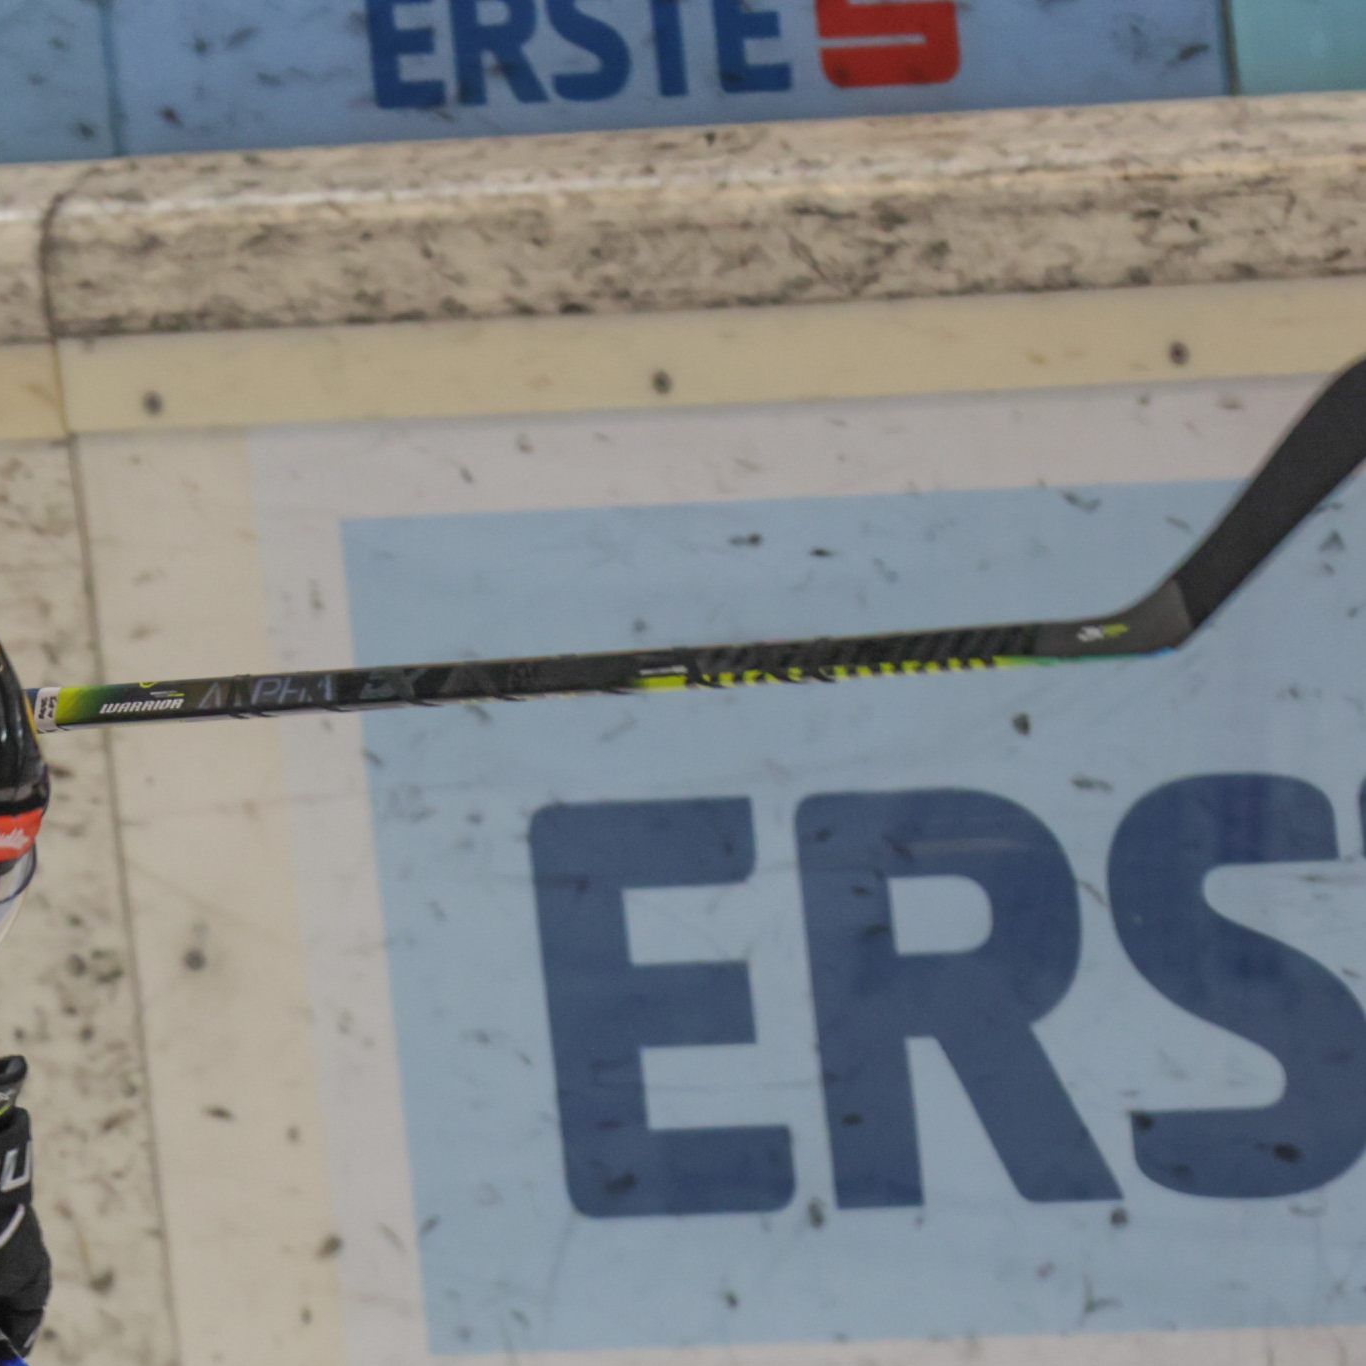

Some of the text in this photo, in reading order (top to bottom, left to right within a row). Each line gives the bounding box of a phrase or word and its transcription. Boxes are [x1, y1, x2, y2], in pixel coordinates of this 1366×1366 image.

[364, 0, 794, 110] ERSTE
[99, 697, 185, 716] WARRIOR
[529, 771, 1366, 1219] ERS
